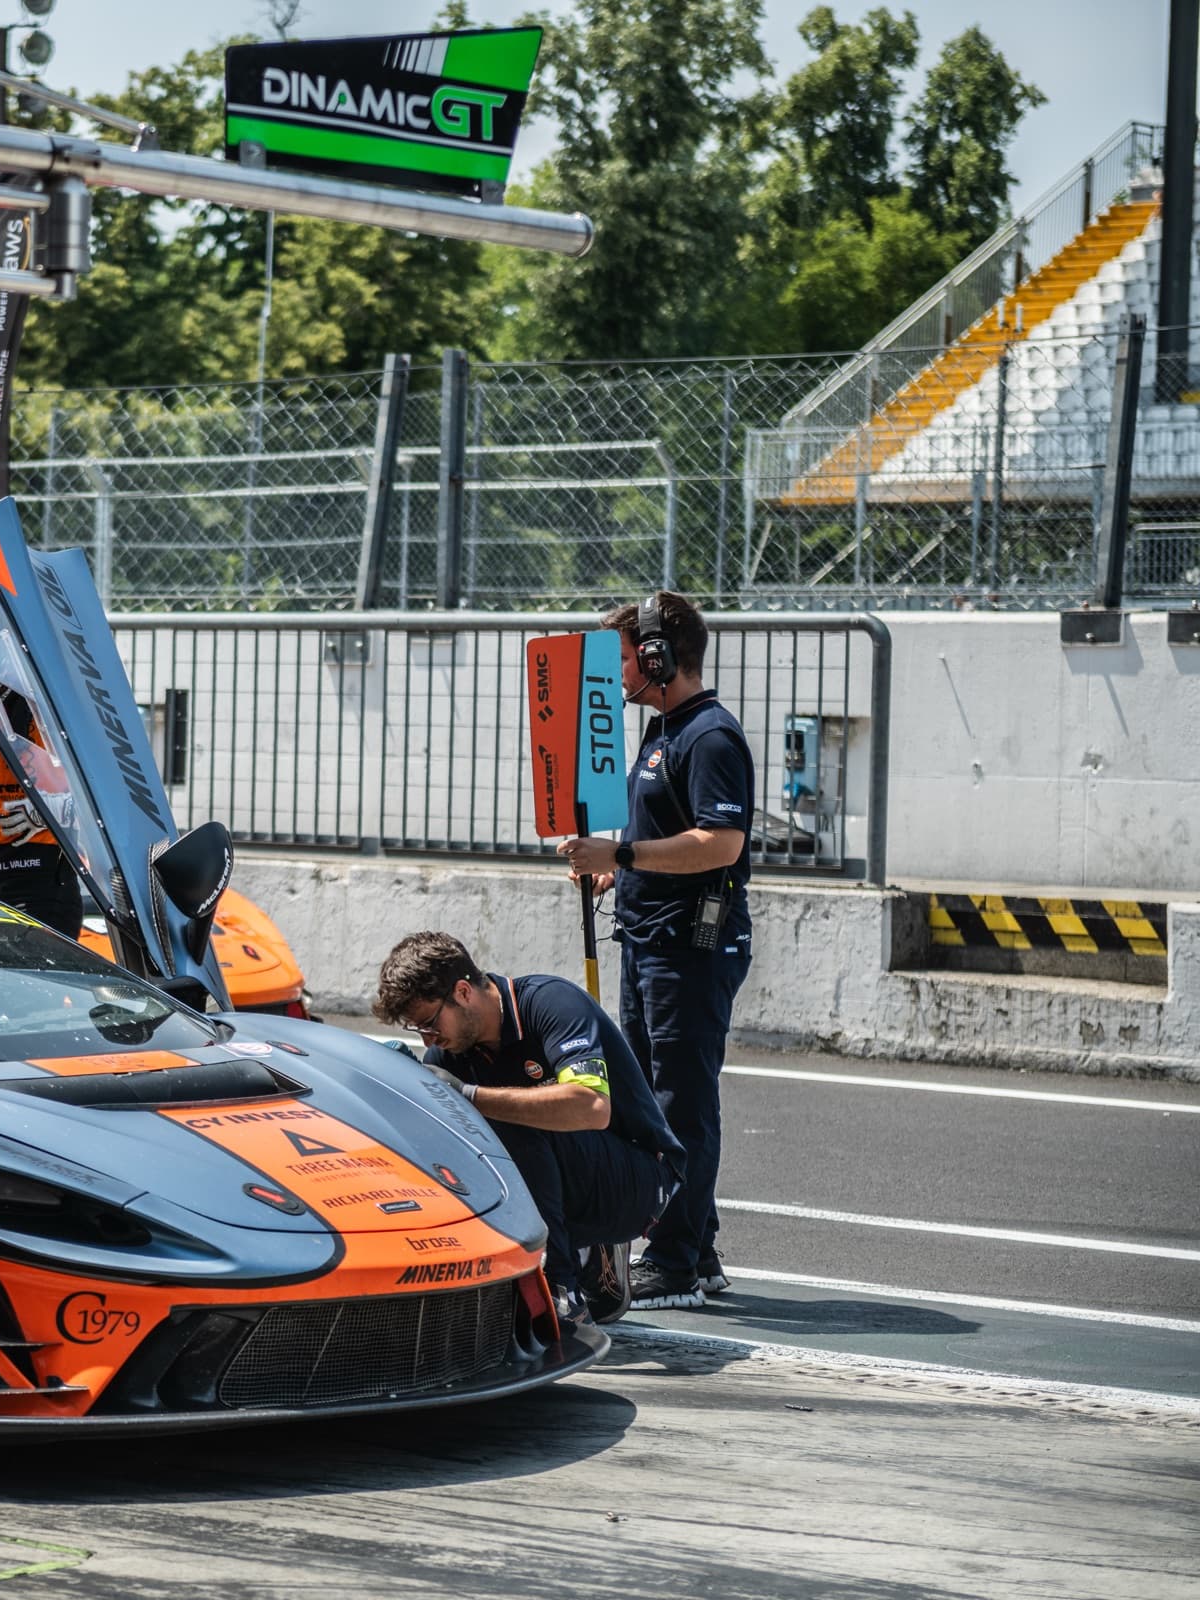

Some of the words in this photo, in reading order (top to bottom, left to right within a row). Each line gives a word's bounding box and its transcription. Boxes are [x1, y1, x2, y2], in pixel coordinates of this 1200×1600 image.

[536, 652, 550, 703] SMC
[62, 629, 166, 831] MINERVA
[585, 675, 615, 775] STOP!
[543, 753, 556, 833] McLaren
[224, 1109, 325, 1125] INVEST
[286, 1160, 341, 1176] THREE
[336, 1156, 395, 1170] MAGNA
[322, 1189, 393, 1208] RICHARD
[393, 1187, 442, 1199] MILLE
[405, 1237, 463, 1252] brose
[395, 1260, 474, 1285] MINERVA
[476, 1258, 493, 1277] OIL
